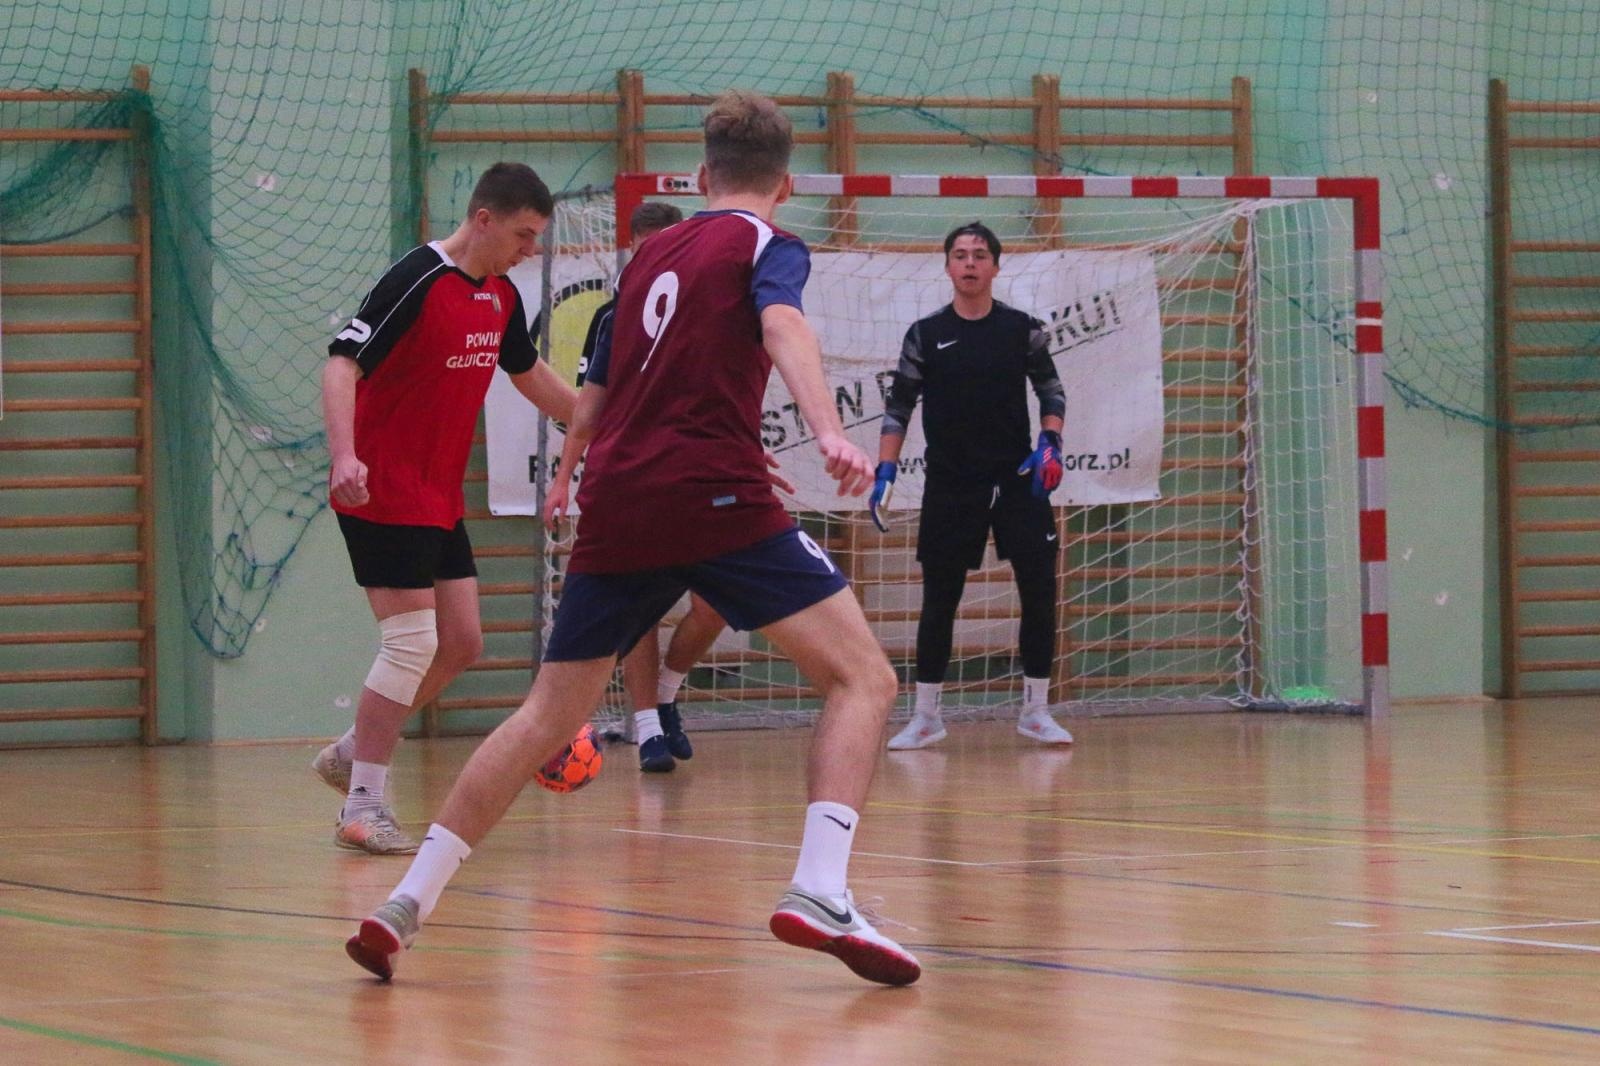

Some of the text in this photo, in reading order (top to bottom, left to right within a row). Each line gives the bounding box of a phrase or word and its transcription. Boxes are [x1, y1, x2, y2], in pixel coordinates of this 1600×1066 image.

[466, 331, 501, 348] POWIA
[642, 271, 680, 372] 9
[798, 530, 836, 574] 9
